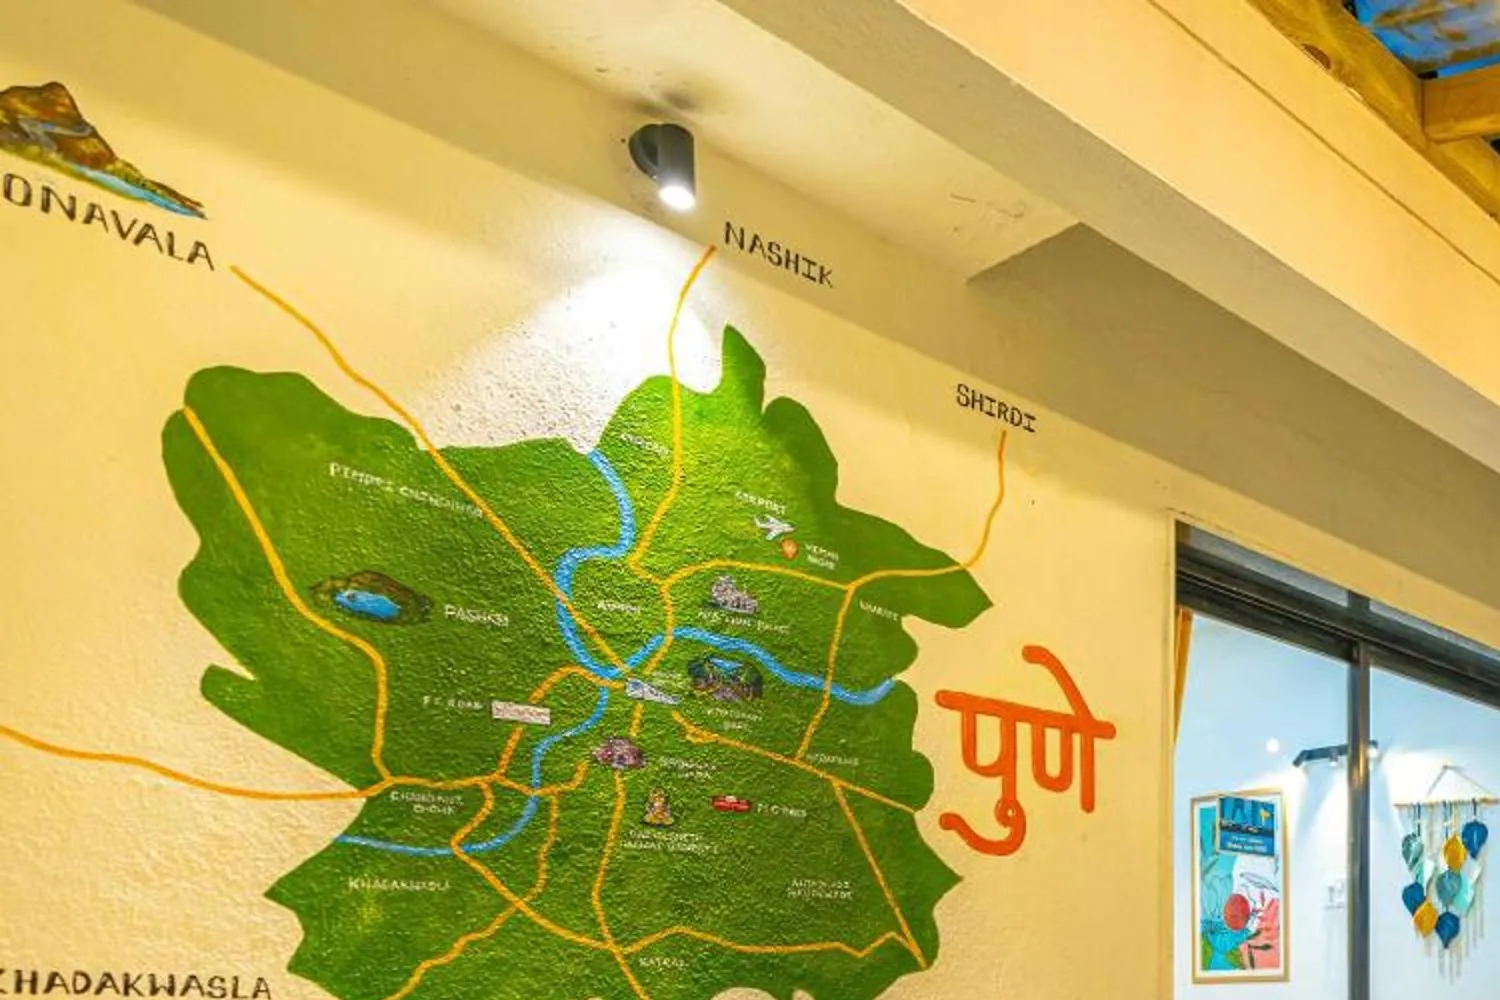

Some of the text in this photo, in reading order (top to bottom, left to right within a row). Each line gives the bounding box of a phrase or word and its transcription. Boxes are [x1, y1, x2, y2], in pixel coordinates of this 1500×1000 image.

[2, 173, 215, 271] ONAVALA
[723, 220, 834, 288] NASHIK
[956, 383, 1036, 434] SHIRDI
[935, 645, 1116, 856] पुणे
